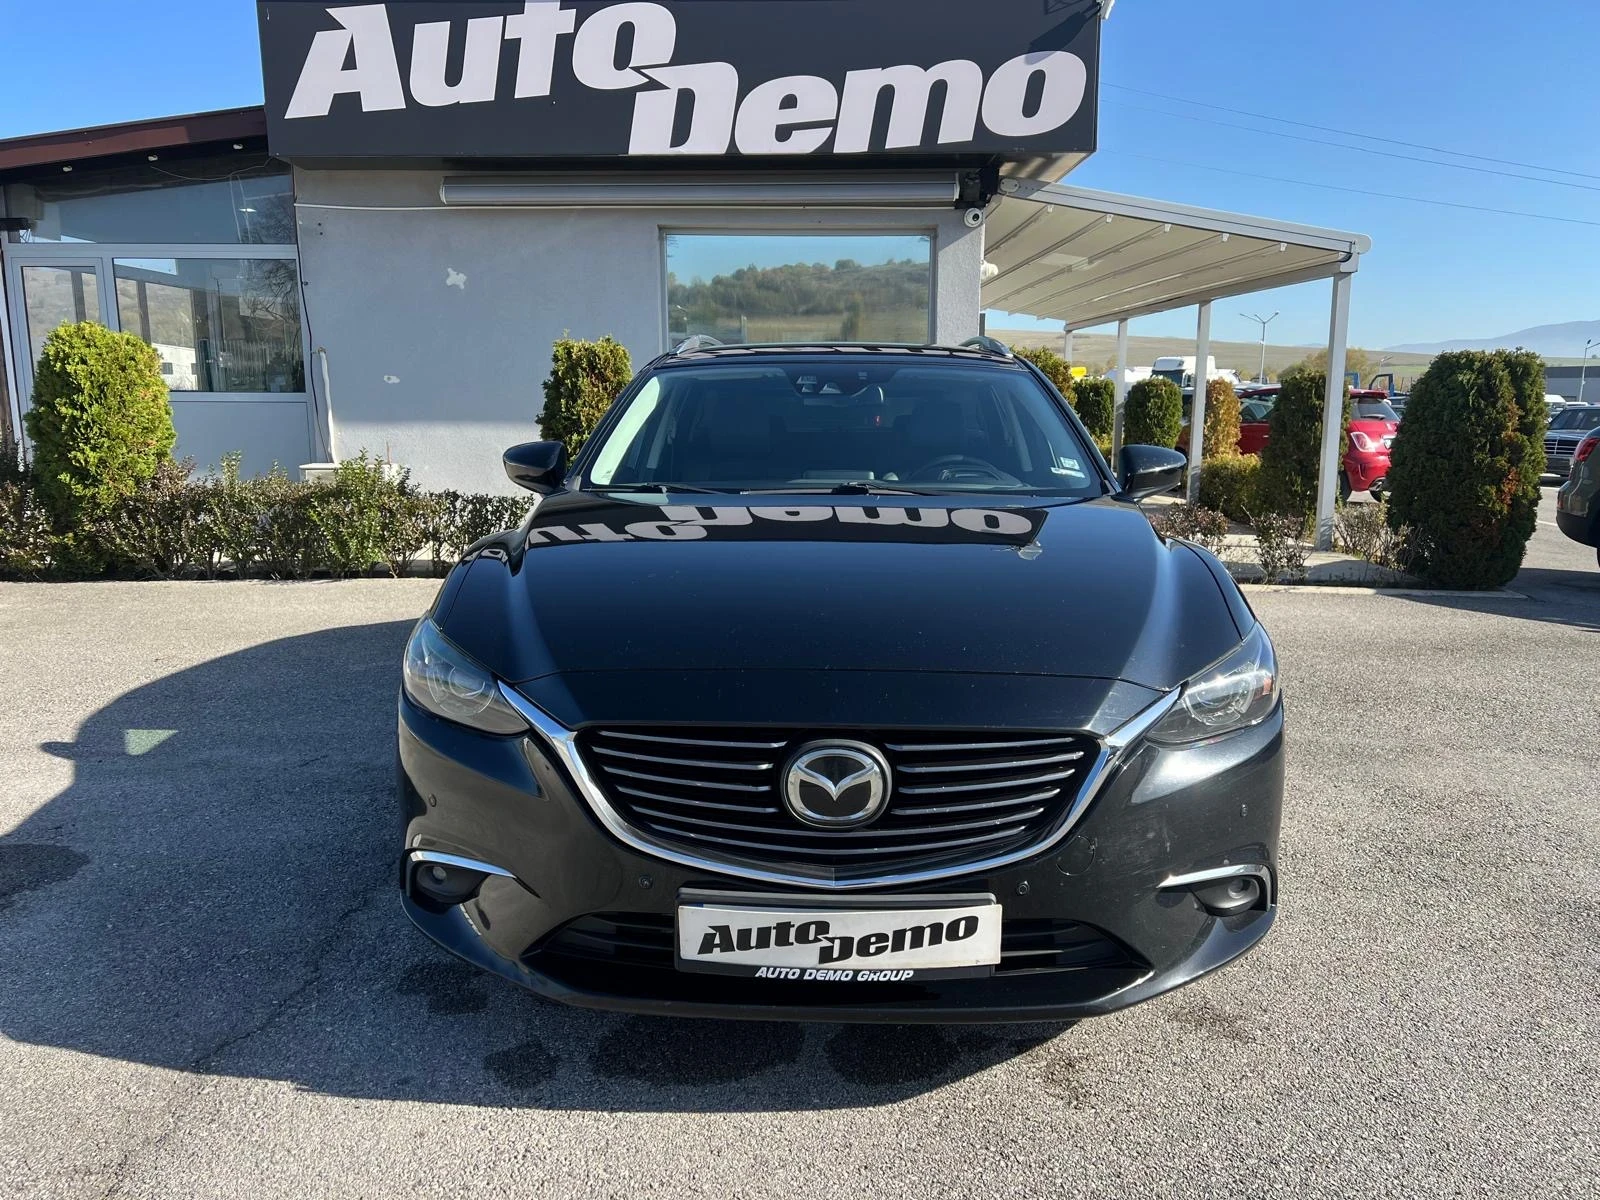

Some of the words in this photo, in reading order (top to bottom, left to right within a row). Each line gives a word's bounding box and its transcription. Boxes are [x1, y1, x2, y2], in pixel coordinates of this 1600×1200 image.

[284, 0, 677, 120] Auto
[628, 50, 1087, 156] Demo
[697, 920, 831, 955] Auto
[818, 915, 979, 965] Demo
[755, 966, 801, 980] AUTO
[803, 968, 853, 981] DEMO
[856, 969, 915, 982] GROUP
